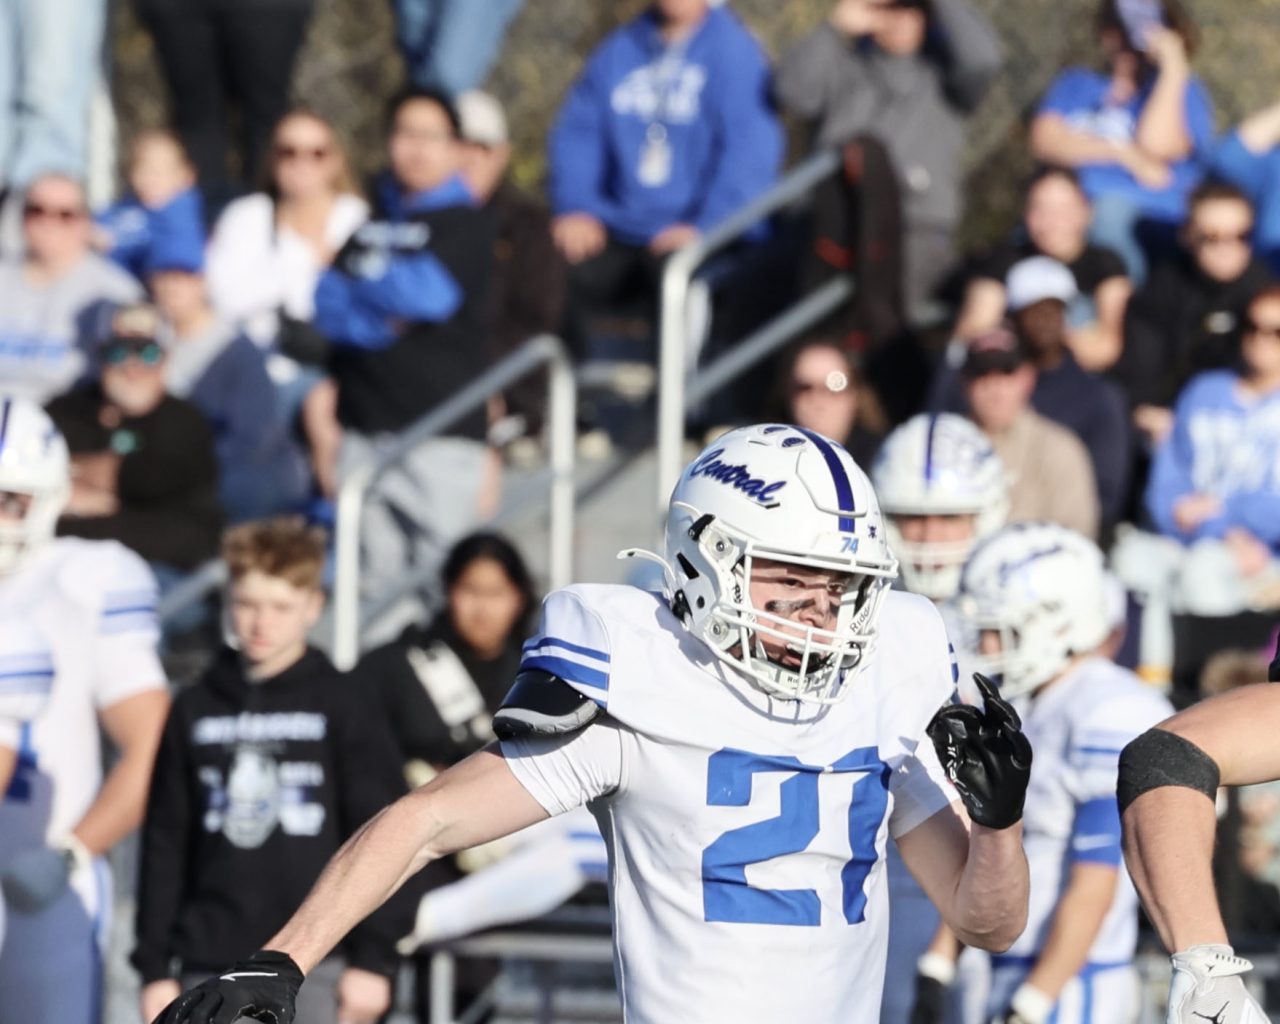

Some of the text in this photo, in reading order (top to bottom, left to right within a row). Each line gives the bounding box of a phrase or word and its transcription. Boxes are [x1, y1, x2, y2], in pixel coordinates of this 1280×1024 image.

[689, 448, 787, 501] Central
[839, 537, 859, 553] 74
[702, 745, 892, 926] 21
